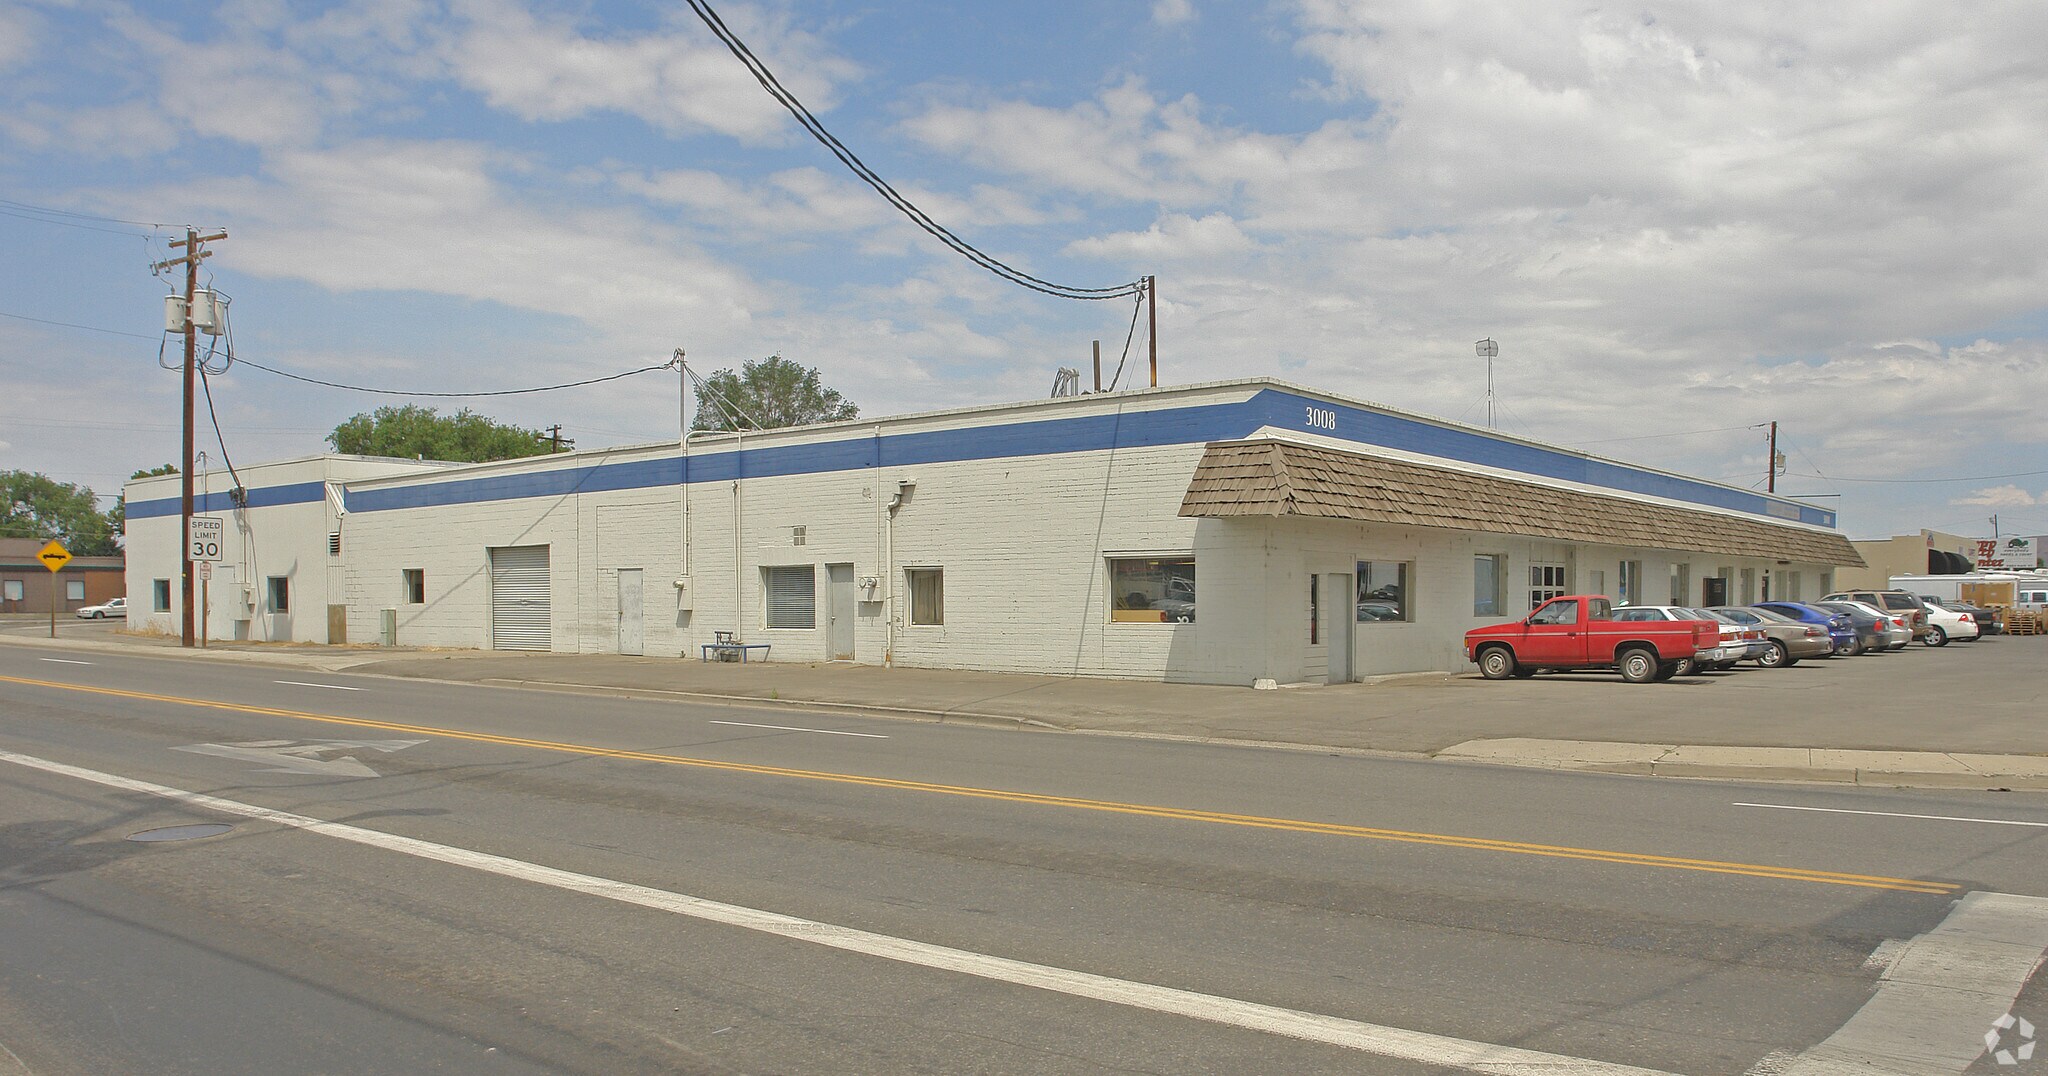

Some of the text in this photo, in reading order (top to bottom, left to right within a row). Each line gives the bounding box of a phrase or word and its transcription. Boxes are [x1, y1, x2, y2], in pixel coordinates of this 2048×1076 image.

[1305, 406, 1336, 430] 3008
[191, 521, 220, 529] SPEED
[193, 542, 218, 556] 30
